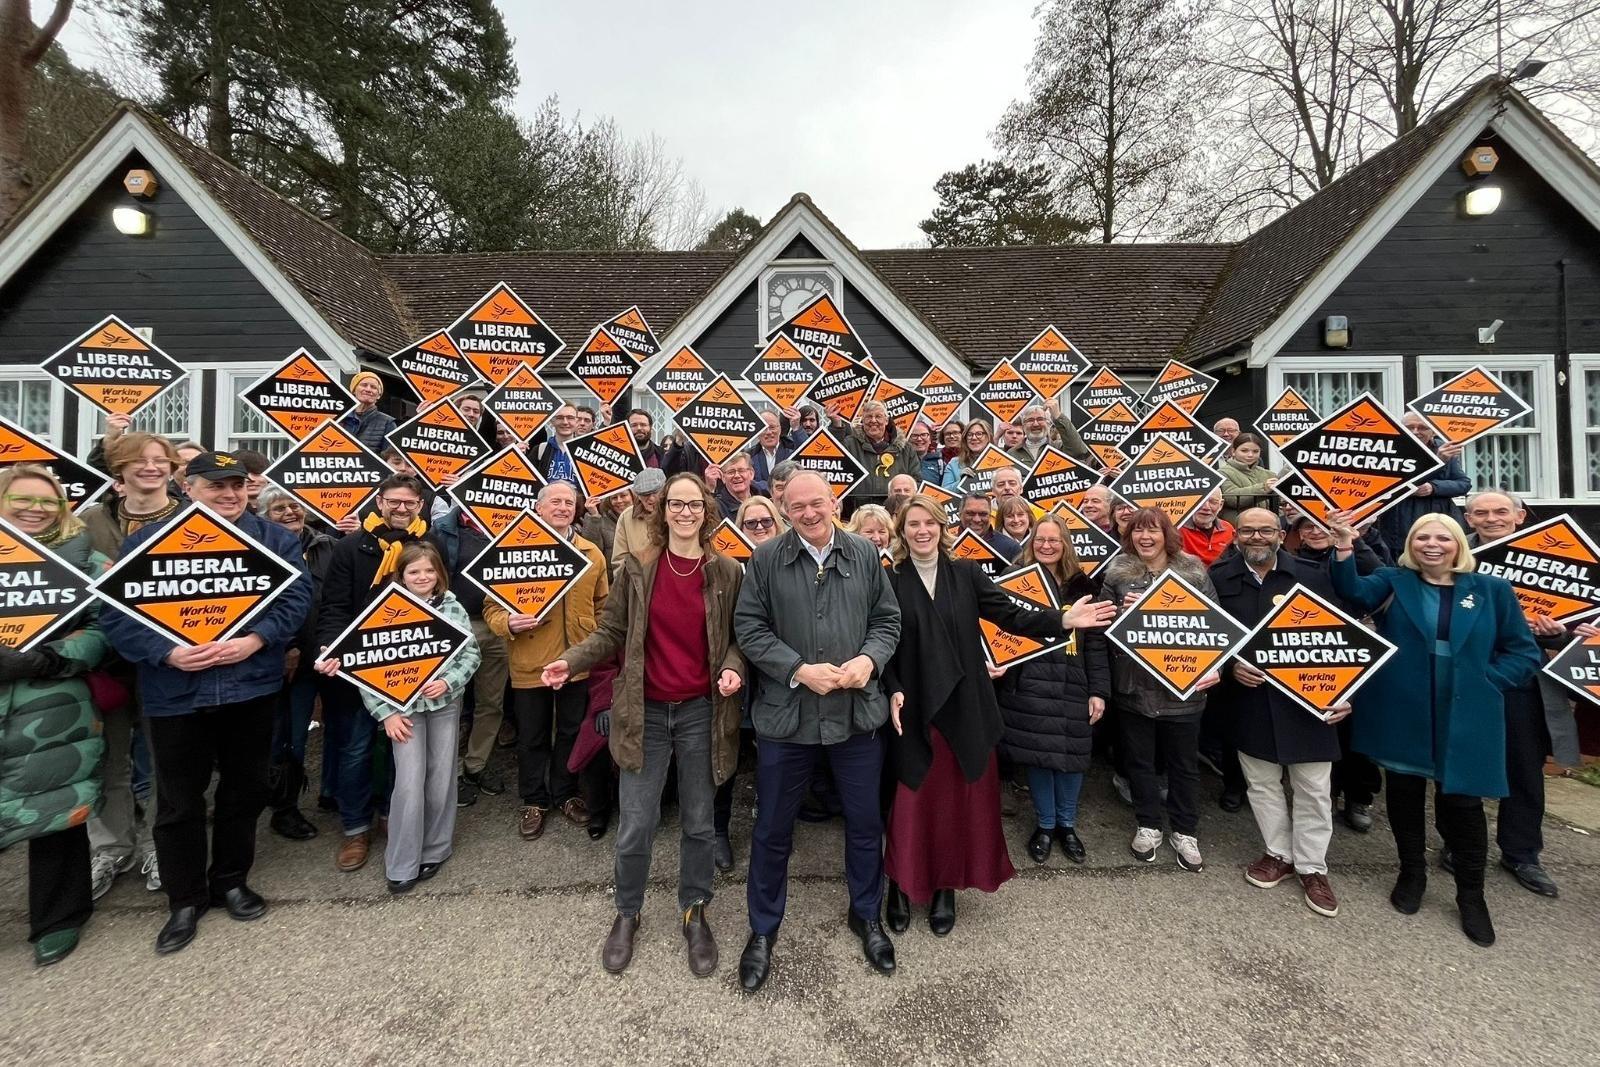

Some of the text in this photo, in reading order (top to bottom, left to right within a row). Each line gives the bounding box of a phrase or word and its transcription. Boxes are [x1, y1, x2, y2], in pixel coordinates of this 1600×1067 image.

[475, 324, 531, 338] LIBERAL
[610, 326, 647, 343] LIBERAL
[794, 328, 842, 347] LIBERAL
[460, 337, 545, 353] DEMOCRATS
[76, 352, 153, 366] LIBERAL
[416, 351, 460, 370] LIBERAL
[587, 355, 622, 364] LIBERAL
[1030, 353, 1069, 363] LIBERAL
[58, 365, 172, 380] DEMOCRATS
[402, 360, 469, 383] DEMOCRATS
[490, 367, 505, 375] For
[578, 365, 633, 375] DEMOCRATS
[764, 361, 802, 371] LIBERAL
[1019, 363, 1078, 373] DEMOCRATS
[666, 372, 704, 381] LIBERAL
[754, 372, 813, 382] DEMOCRATS
[821, 369, 856, 387] LIBERAL
[275, 383, 331, 397] LIBERAL
[423, 379, 445, 389] Working
[656, 382, 707, 391] DEMOCRAT
[815, 376, 868, 400] DEMOCRATS
[922, 386, 954, 395] LIBERAL
[989, 382, 1022, 391] LIBERAL
[1160, 378, 1196, 392] LIBERAL
[102, 388, 142, 398] Working
[505, 391, 543, 400] LIBERAL
[981, 391, 1034, 400] DEMOCRATS
[1091, 389, 1123, 397] LIBERAL
[1152, 383, 1208, 403] DEMOCRATS
[102, 396, 138, 405] For You
[259, 395, 344, 411] DEMOCRATS
[494, 401, 553, 411] DEMOCRATS
[1441, 394, 1497, 406] LIBERAL
[695, 406, 744, 420] LIBERAL
[1423, 404, 1509, 418] DEMOCRATS
[291, 415, 318, 423] Working
[682, 417, 756, 432] DEMOCRATS
[1448, 419, 1478, 428] Working
[416, 426, 466, 442] LIBERAL
[1461, 426, 1474, 434] You
[401, 438, 478, 456] DEMOCRATS
[707, 438, 734, 446] Working
[1319, 435, 1397, 454] LIBERAL
[590, 441, 631, 467] LIBERAL
[718, 445, 730, 453] You
[301, 456, 364, 468] LIBERAL
[427, 457, 452, 467] Working
[574, 446, 637, 481] DEMOCRATS
[801, 459, 843, 471] LIBERAL
[1296, 449, 1416, 473] DEMOCRATS
[284, 470, 381, 483] DEMOCRATS
[590, 471, 612, 484] Working
[1036, 470, 1078, 486] LIBERAL
[1135, 467, 1194, 481] LIBERAL
[482, 478, 534, 495] LIBERAL
[588, 478, 608, 489] For You
[1122, 478, 1210, 494] DEMOCRATS
[1332, 475, 1371, 488] Working
[1028, 479, 1091, 499] DEMOCRATS
[1329, 487, 1367, 498] For You
[320, 492, 352, 500] Working
[465, 490, 537, 510] DEMOCRAT
[321, 500, 351, 509] For You
[1156, 500, 1186, 508] Working
[492, 513, 515, 521] Workin
[499, 550, 559, 564] LIBERAL
[152, 558, 247, 576] LIBERAL
[483, 564, 573, 581] DEMOCRATS
[1505, 551, 1590, 581] LIBERAL
[124, 576, 271, 598] DEMOCRATS
[516, 585, 545, 595] Working
[518, 595, 544, 604] For You
[180, 604, 227, 617] Working
[1532, 606, 1551, 616] You
[182, 615, 225, 628] For You
[1142, 614, 1210, 629] LIBERAL
[362, 626, 433, 647] LIBERAL
[995, 629, 1022, 647] Working
[1126, 630, 1229, 647] DEMOCRATS
[1272, 631, 1348, 647] LIBERAL
[343, 640, 451, 667] DEMOCRATS
[990, 639, 1018, 655] For You
[1163, 654, 1197, 663] Working
[1256, 648, 1371, 664] DEMOCRATS
[384, 667, 419, 678] Working
[1166, 664, 1196, 673] For You
[387, 676, 419, 688] For You
[1298, 672, 1336, 682] Working
[1301, 682, 1336, 692] For You
